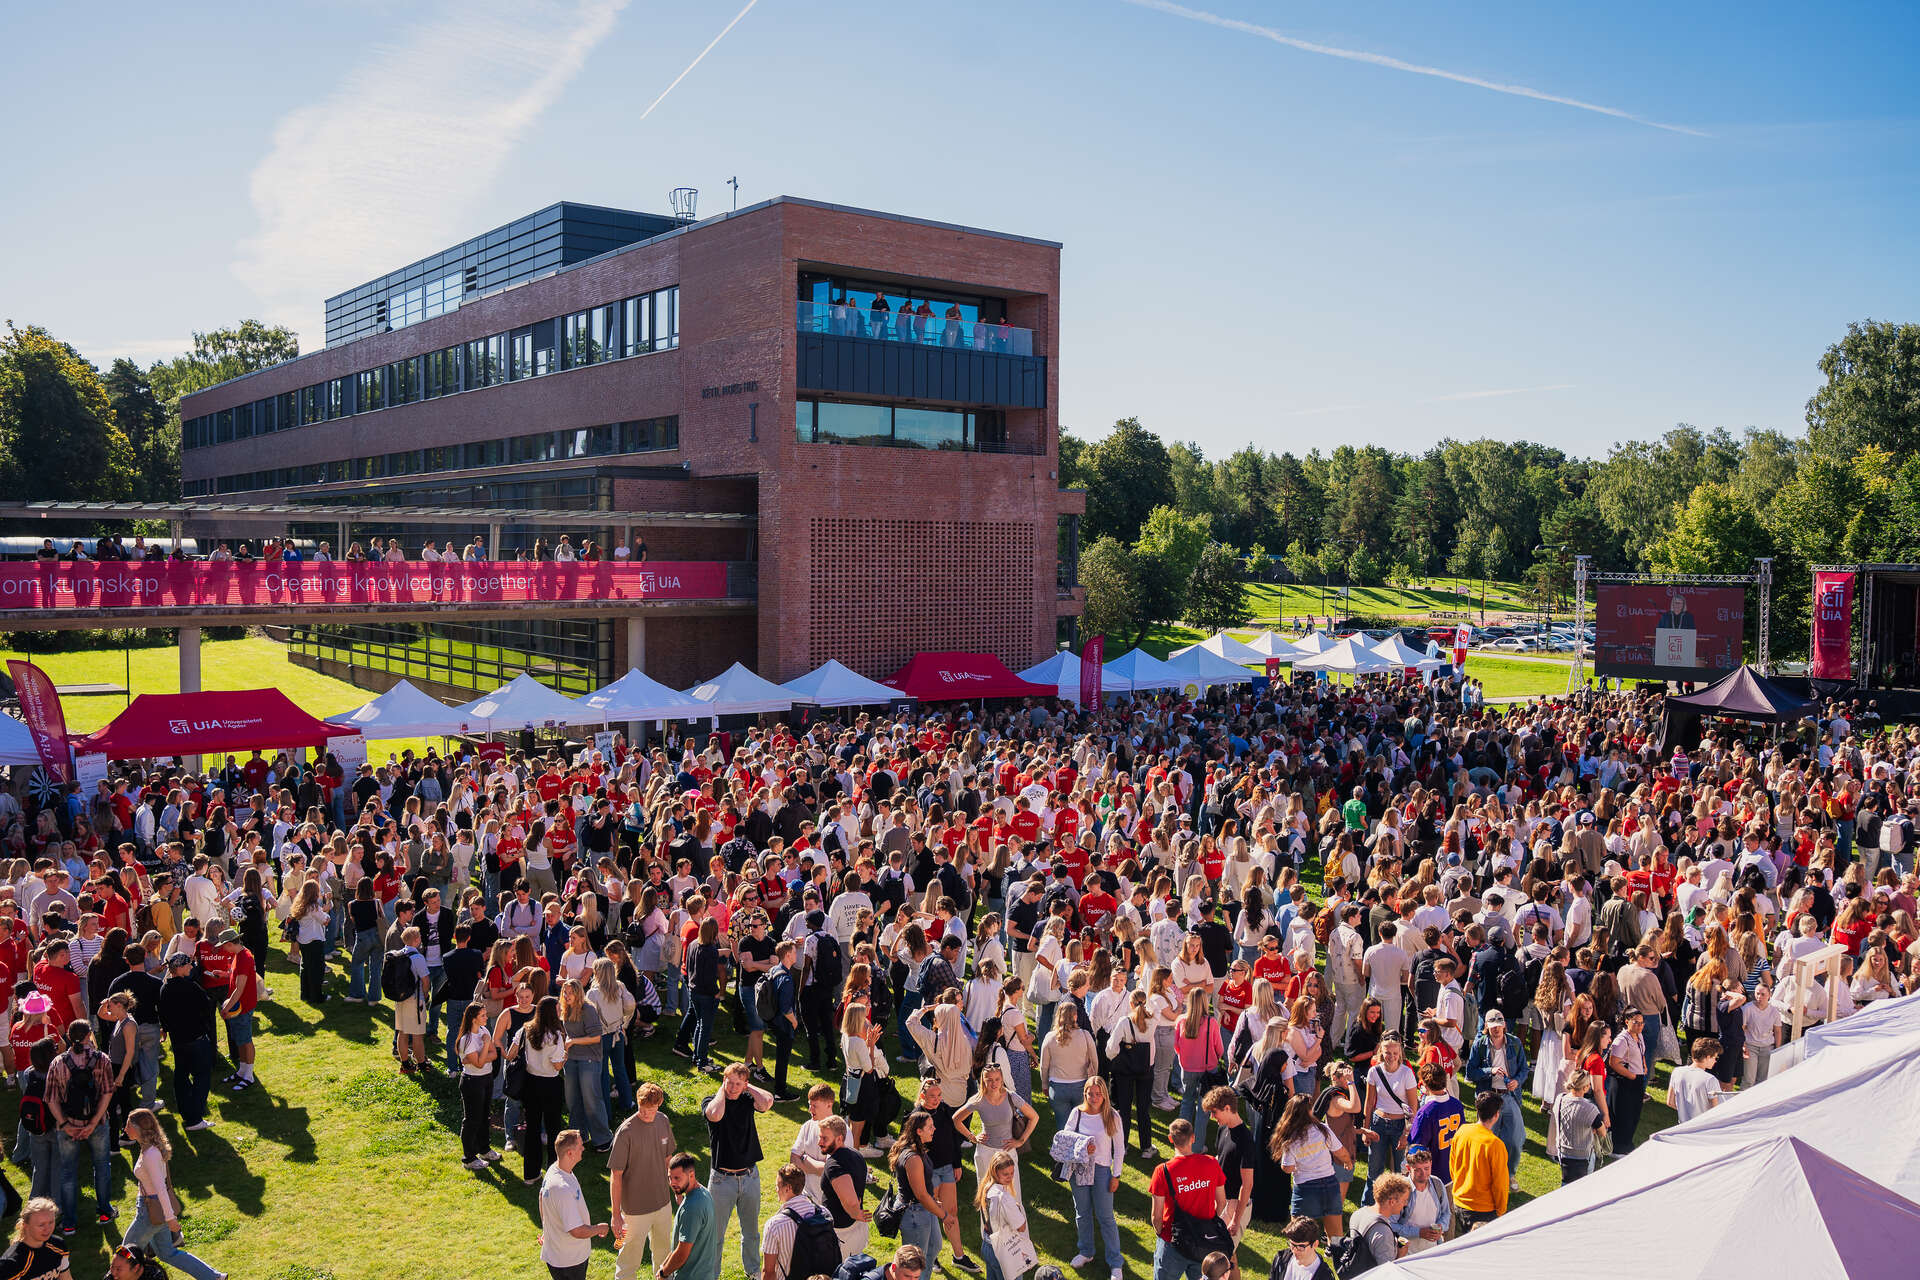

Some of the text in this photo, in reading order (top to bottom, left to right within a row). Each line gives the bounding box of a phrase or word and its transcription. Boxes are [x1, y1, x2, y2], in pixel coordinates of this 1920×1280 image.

[2, 573, 160, 597] om kunnskap
[265, 572, 536, 596] Creating knowledge together
[659, 576, 680, 588] UiA
[1822, 610, 1842, 620] UiA
[193, 720, 222, 730] UiA
[12, 1039, 33, 1048] Fadde
[1178, 1180, 1210, 1194] Fadder
